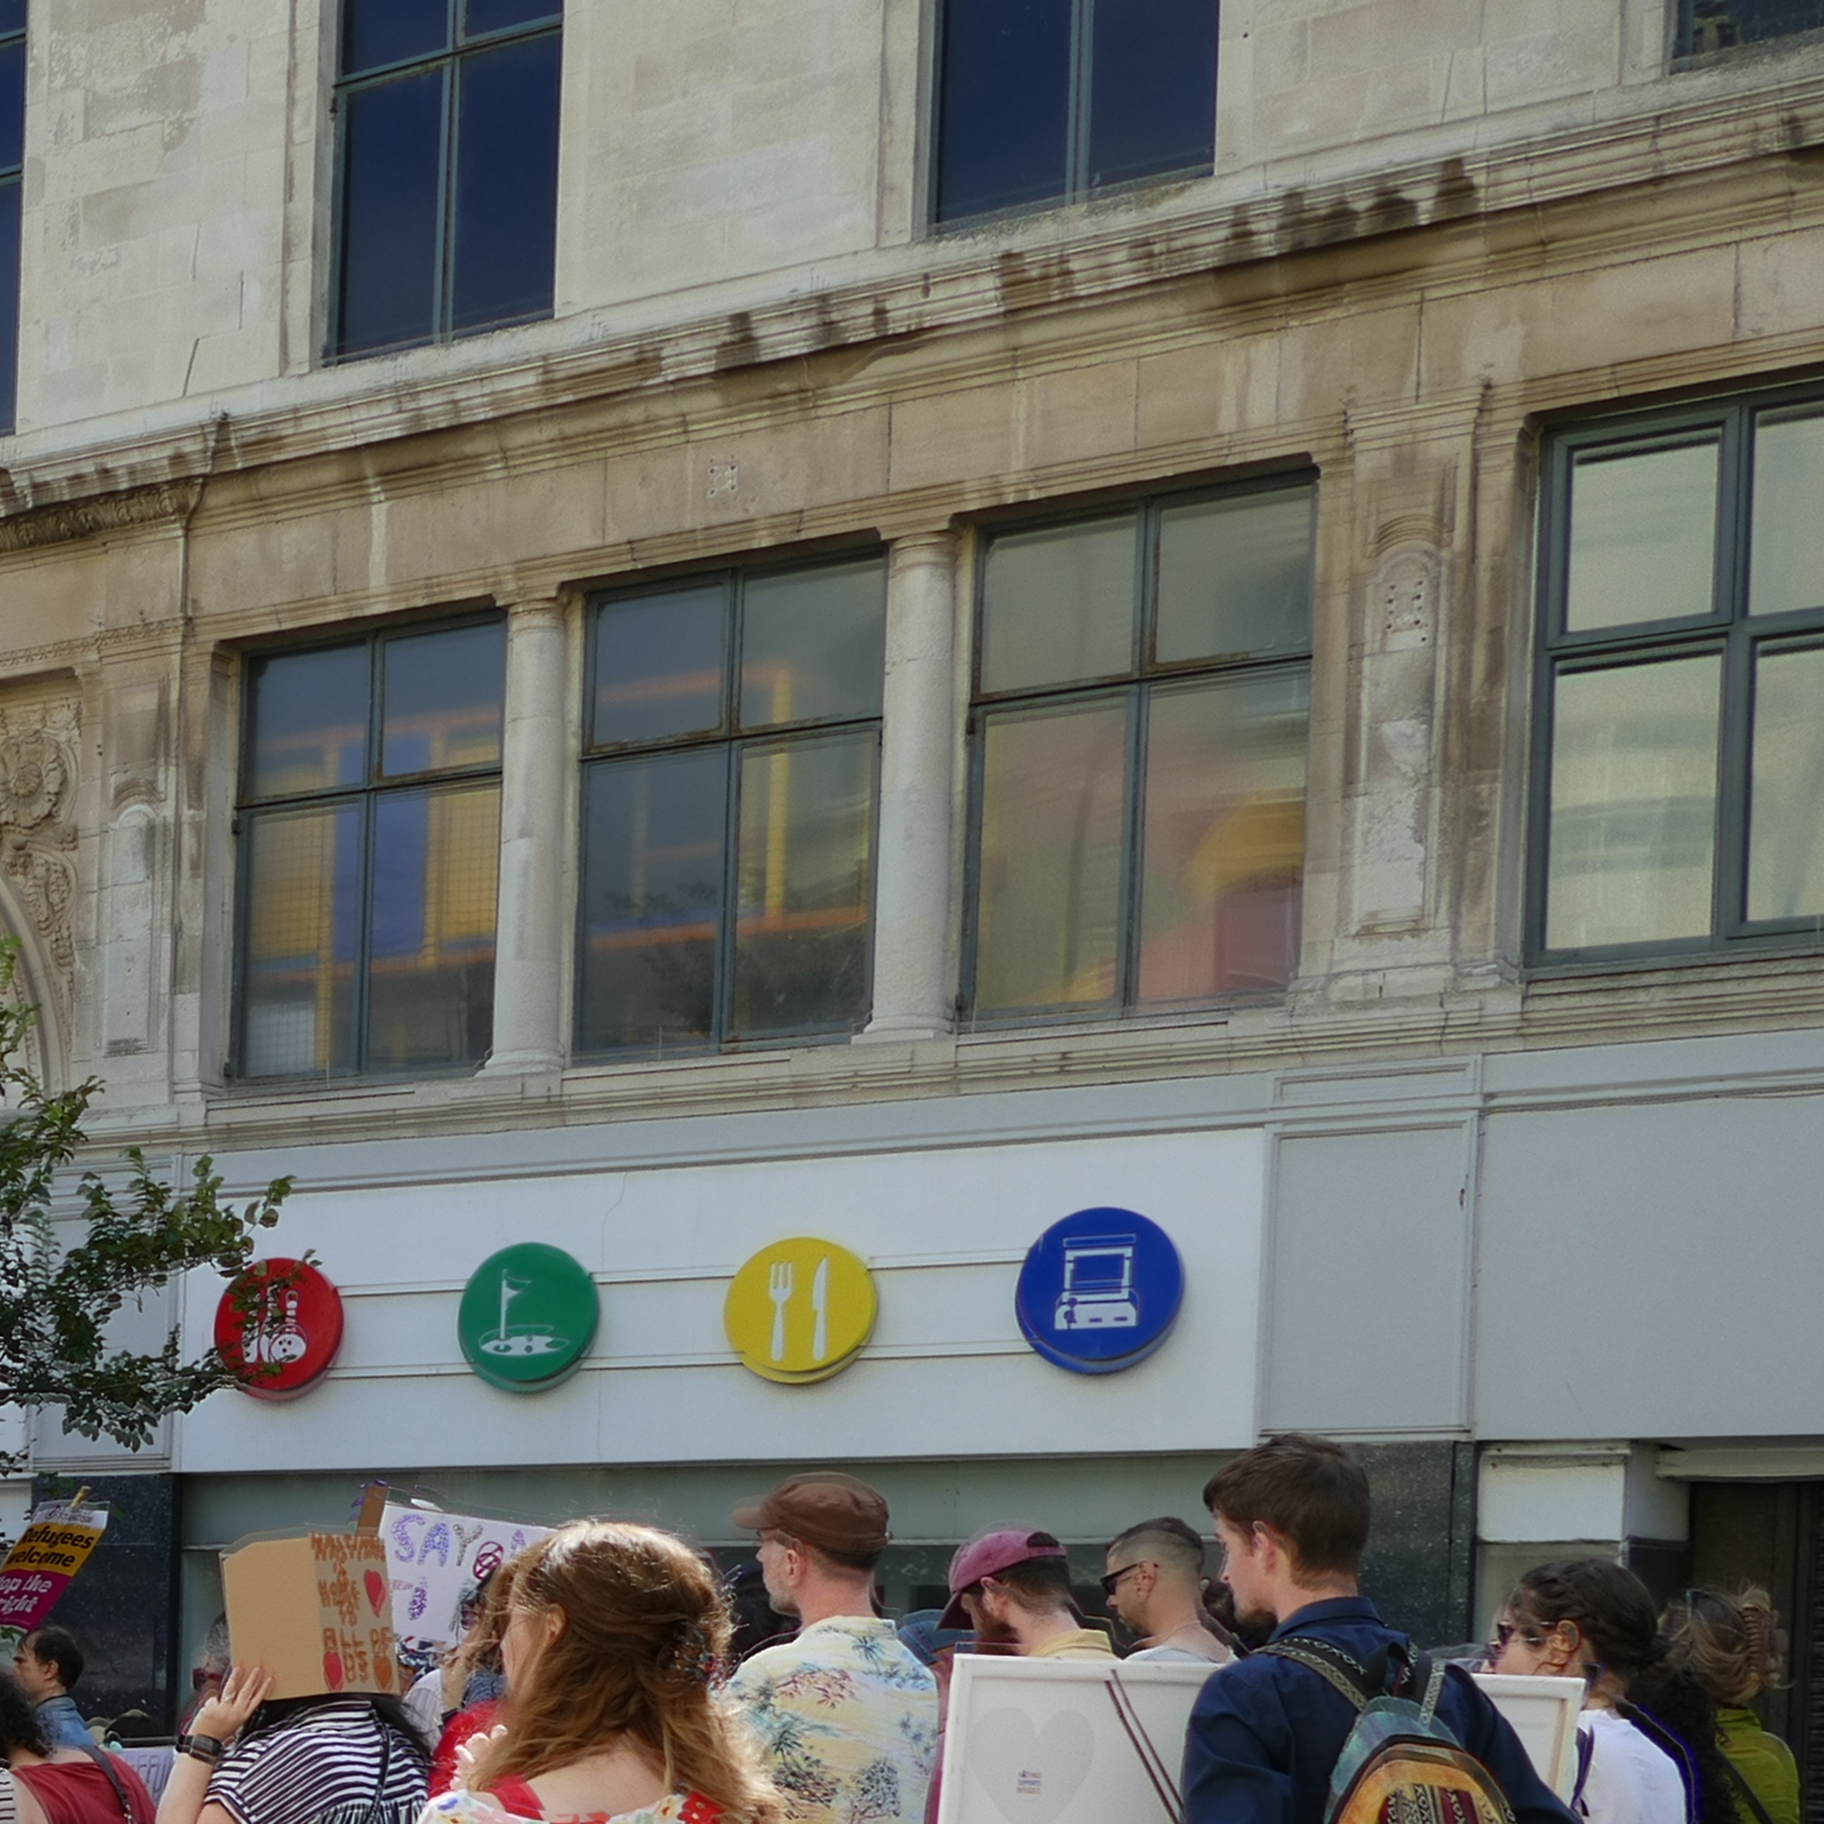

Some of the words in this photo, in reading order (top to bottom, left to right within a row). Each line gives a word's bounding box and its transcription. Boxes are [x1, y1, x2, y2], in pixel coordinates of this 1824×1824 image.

[20, 1525, 95, 1550] Refugees
[391, 1513, 484, 1568] SAY
[5, 1546, 76, 1568] welcome
[22, 1573, 54, 1594] the
